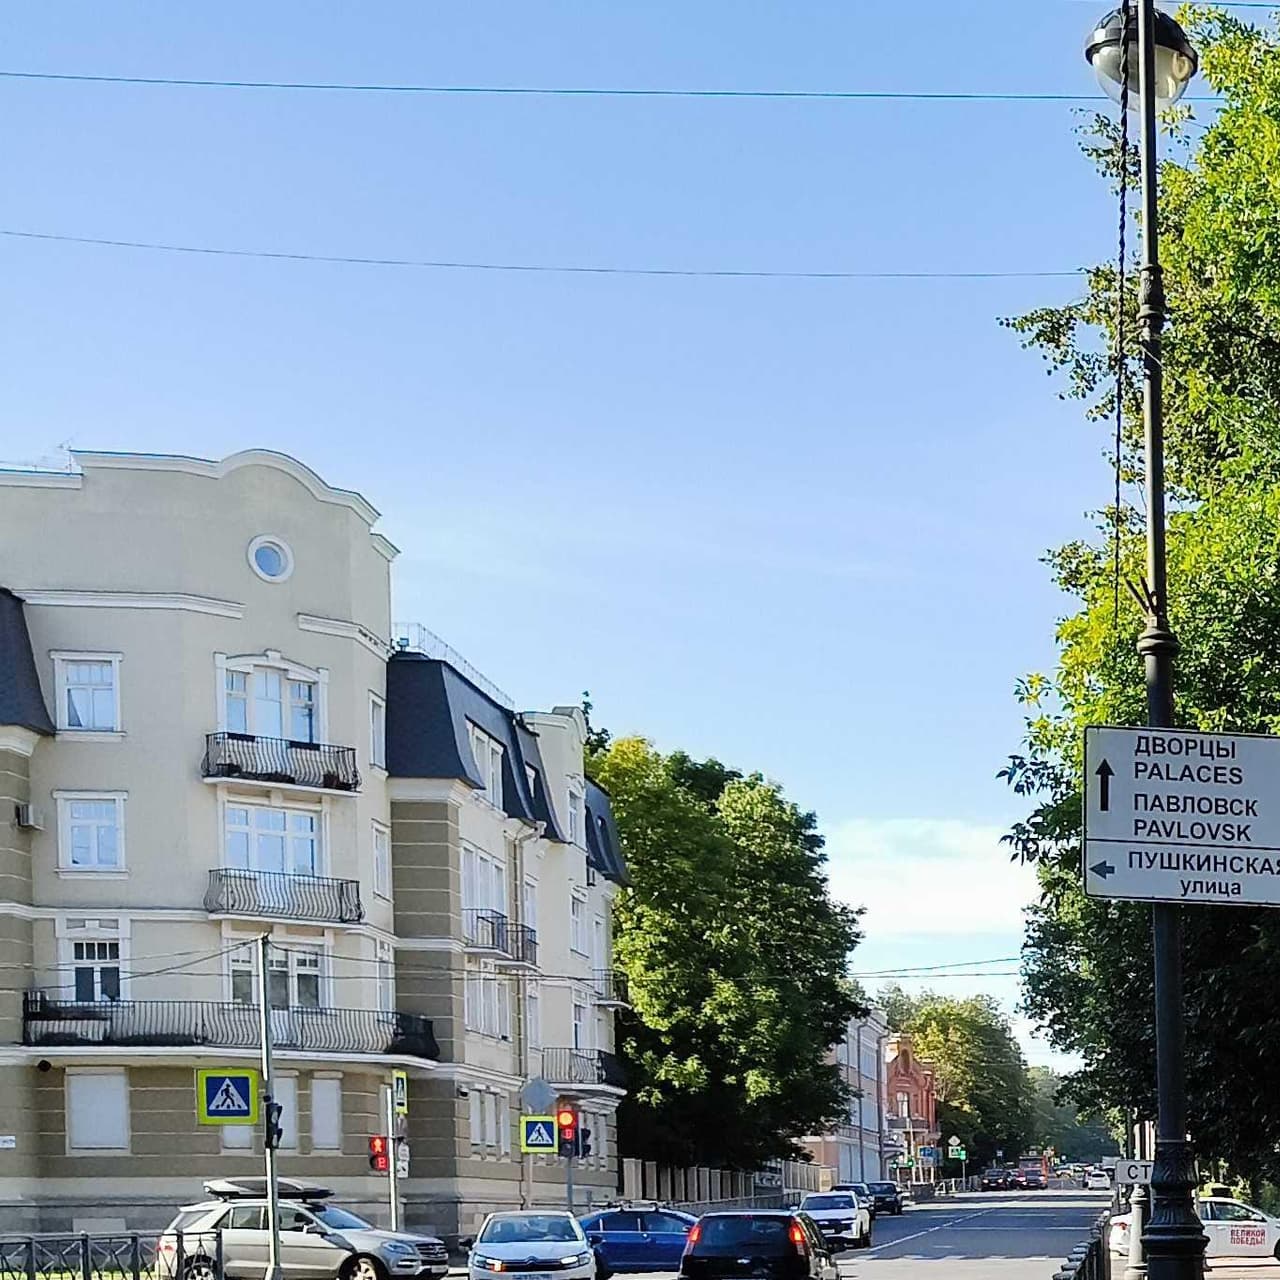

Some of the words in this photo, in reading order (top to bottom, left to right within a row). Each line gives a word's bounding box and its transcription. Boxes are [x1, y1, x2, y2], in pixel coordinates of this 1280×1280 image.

[1134, 735, 1236, 761] ДВОРЦЫ
[1134, 761, 1243, 785] PALACES
[1133, 793, 1258, 817] ПАВЛОВСК
[1133, 818, 1252, 842] PAVLOVSK
[1180, 879, 1242, 897] улица
[1127, 1164, 1152, 1180] СТ
[1230, 1229, 1266, 1237] ВЕЛИКОЙ
